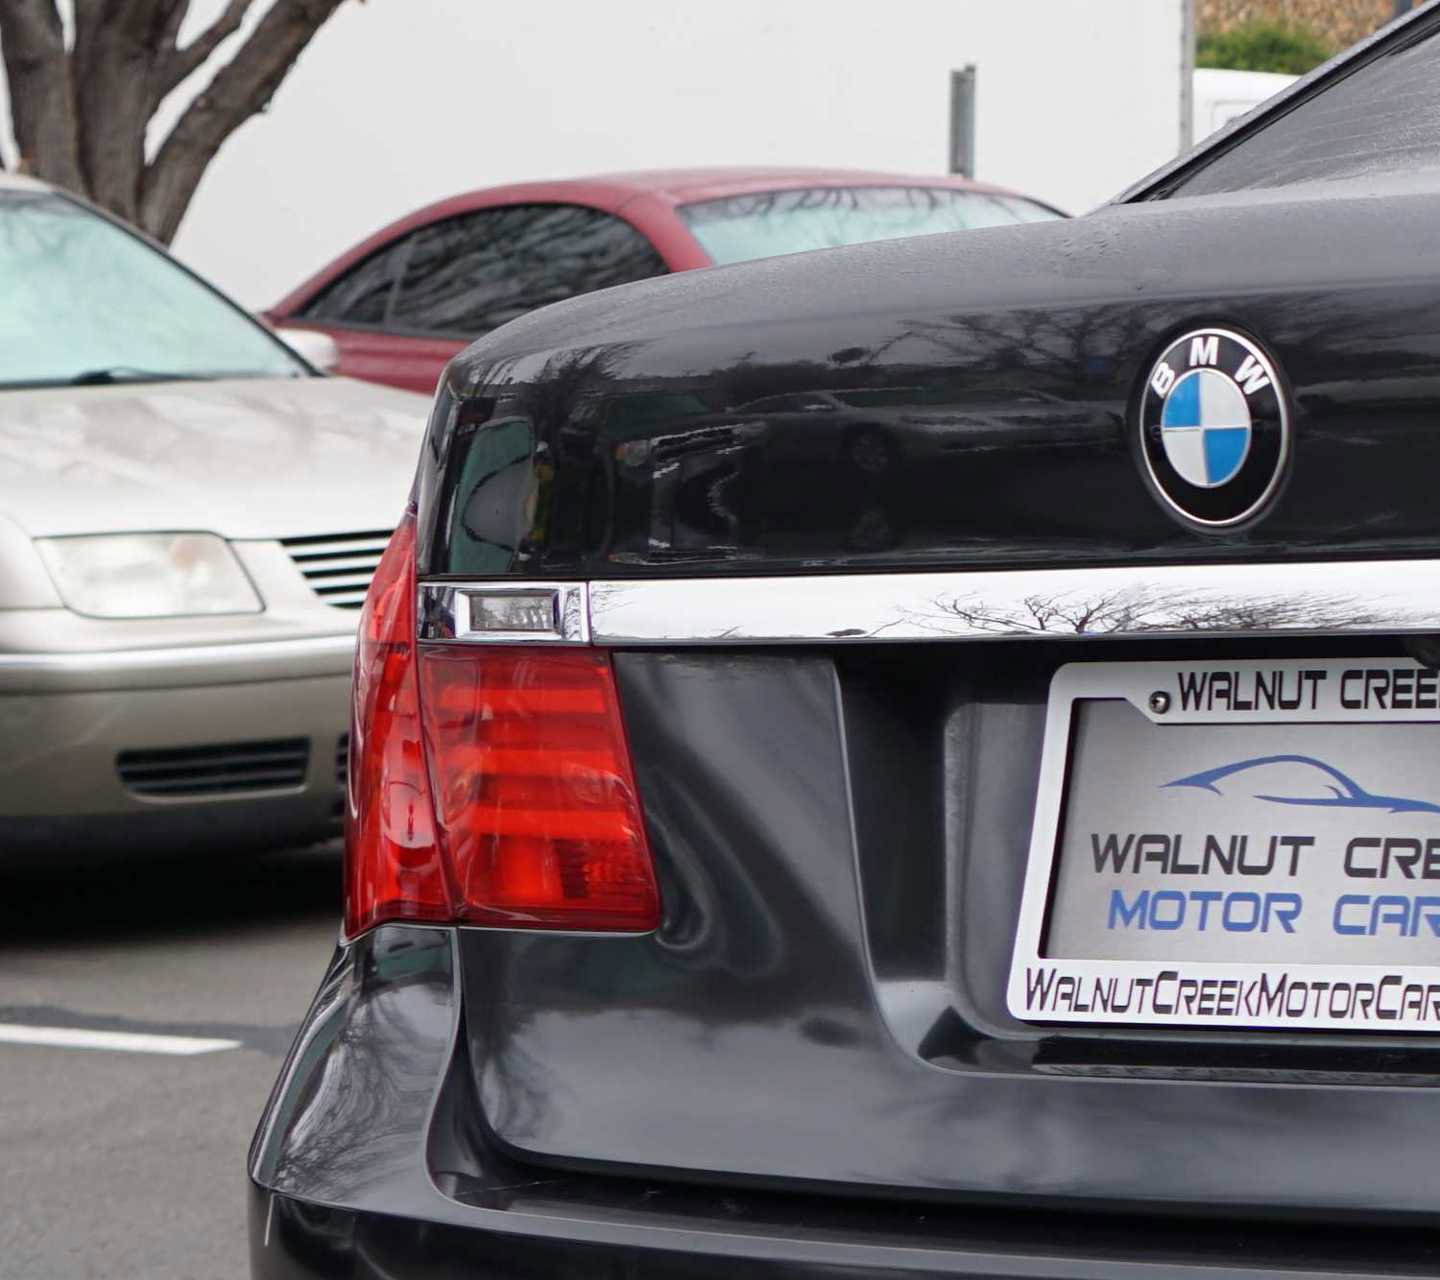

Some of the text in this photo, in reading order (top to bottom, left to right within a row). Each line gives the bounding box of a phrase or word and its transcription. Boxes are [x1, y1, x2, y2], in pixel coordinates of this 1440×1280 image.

[1151, 336, 1271, 399] BMW
[1178, 669, 1328, 711] WALNUT
[1091, 832, 1316, 877] WALNUT
[1106, 889, 1303, 934] MOTOR
